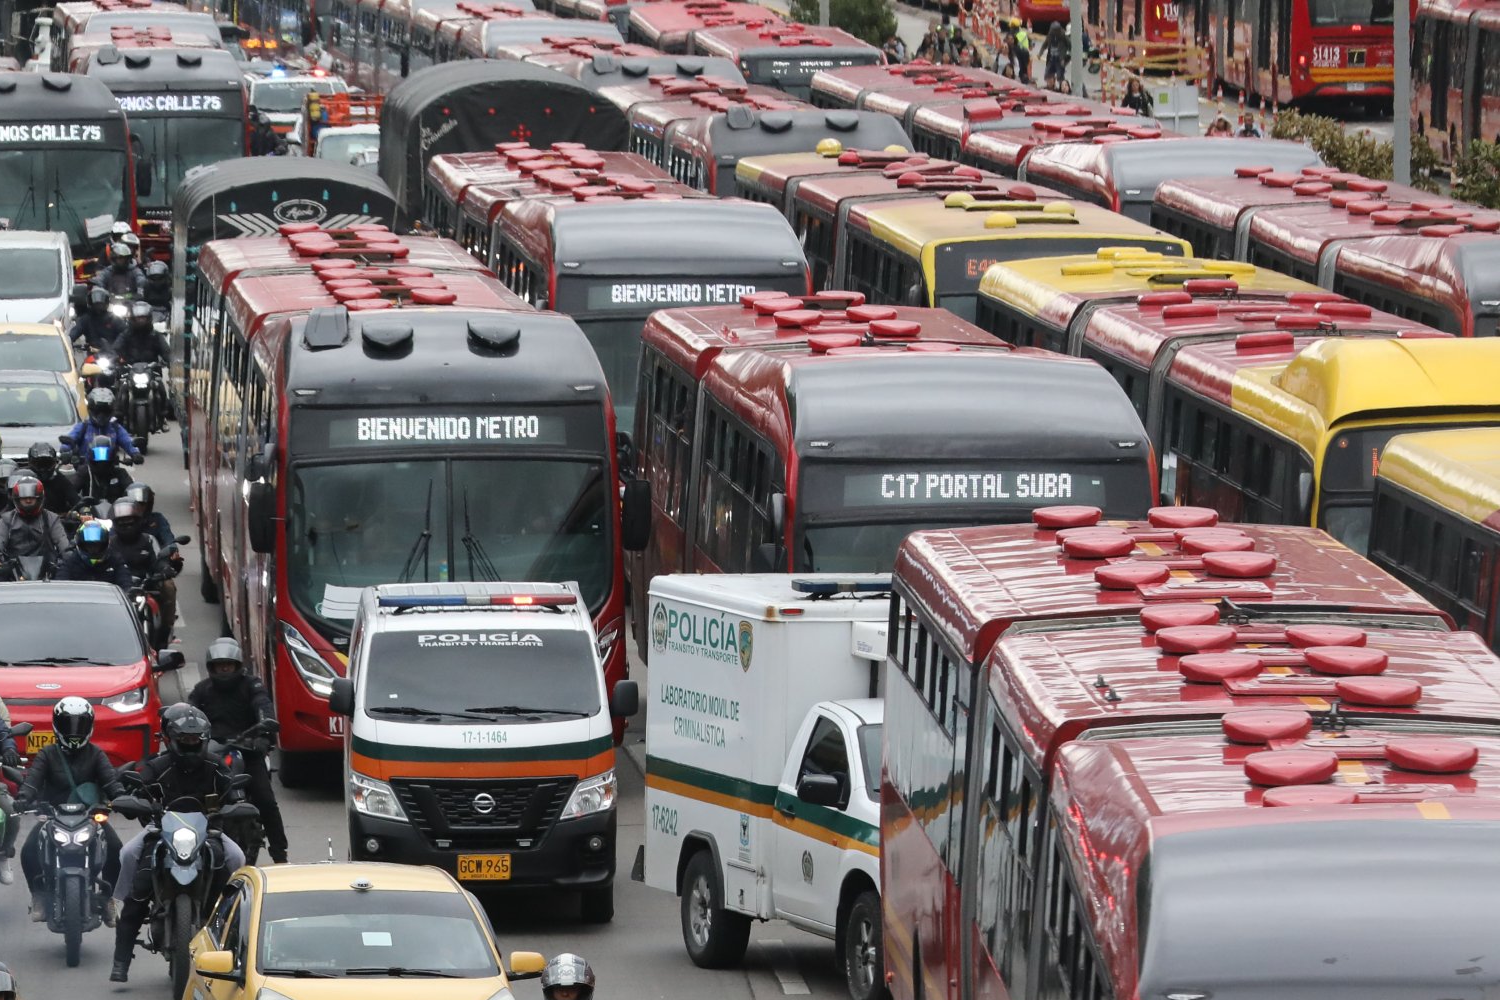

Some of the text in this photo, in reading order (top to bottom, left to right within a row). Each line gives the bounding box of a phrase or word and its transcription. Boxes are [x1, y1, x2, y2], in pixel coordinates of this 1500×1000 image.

[156, 96, 201, 111] CALLE
[203, 96, 221, 110] 75
[32, 125, 80, 140] CALLE
[82, 125, 101, 140] 75
[611, 284, 701, 303] BIENVENIDO
[358, 415, 539, 441] BIENVENIDO METRO
[881, 473, 1072, 498] C17 PORTAL SUBA
[418, 631, 543, 643] POLICÍA
[668, 608, 738, 653] POLICÍA
[701, 648, 739, 665] TRANSPORTE
[661, 684, 707, 713] LABORATORIO
[730, 700, 740, 722] DE
[462, 731, 508, 743] 17-1-1464
[651, 804, 678, 836] 17-6242
